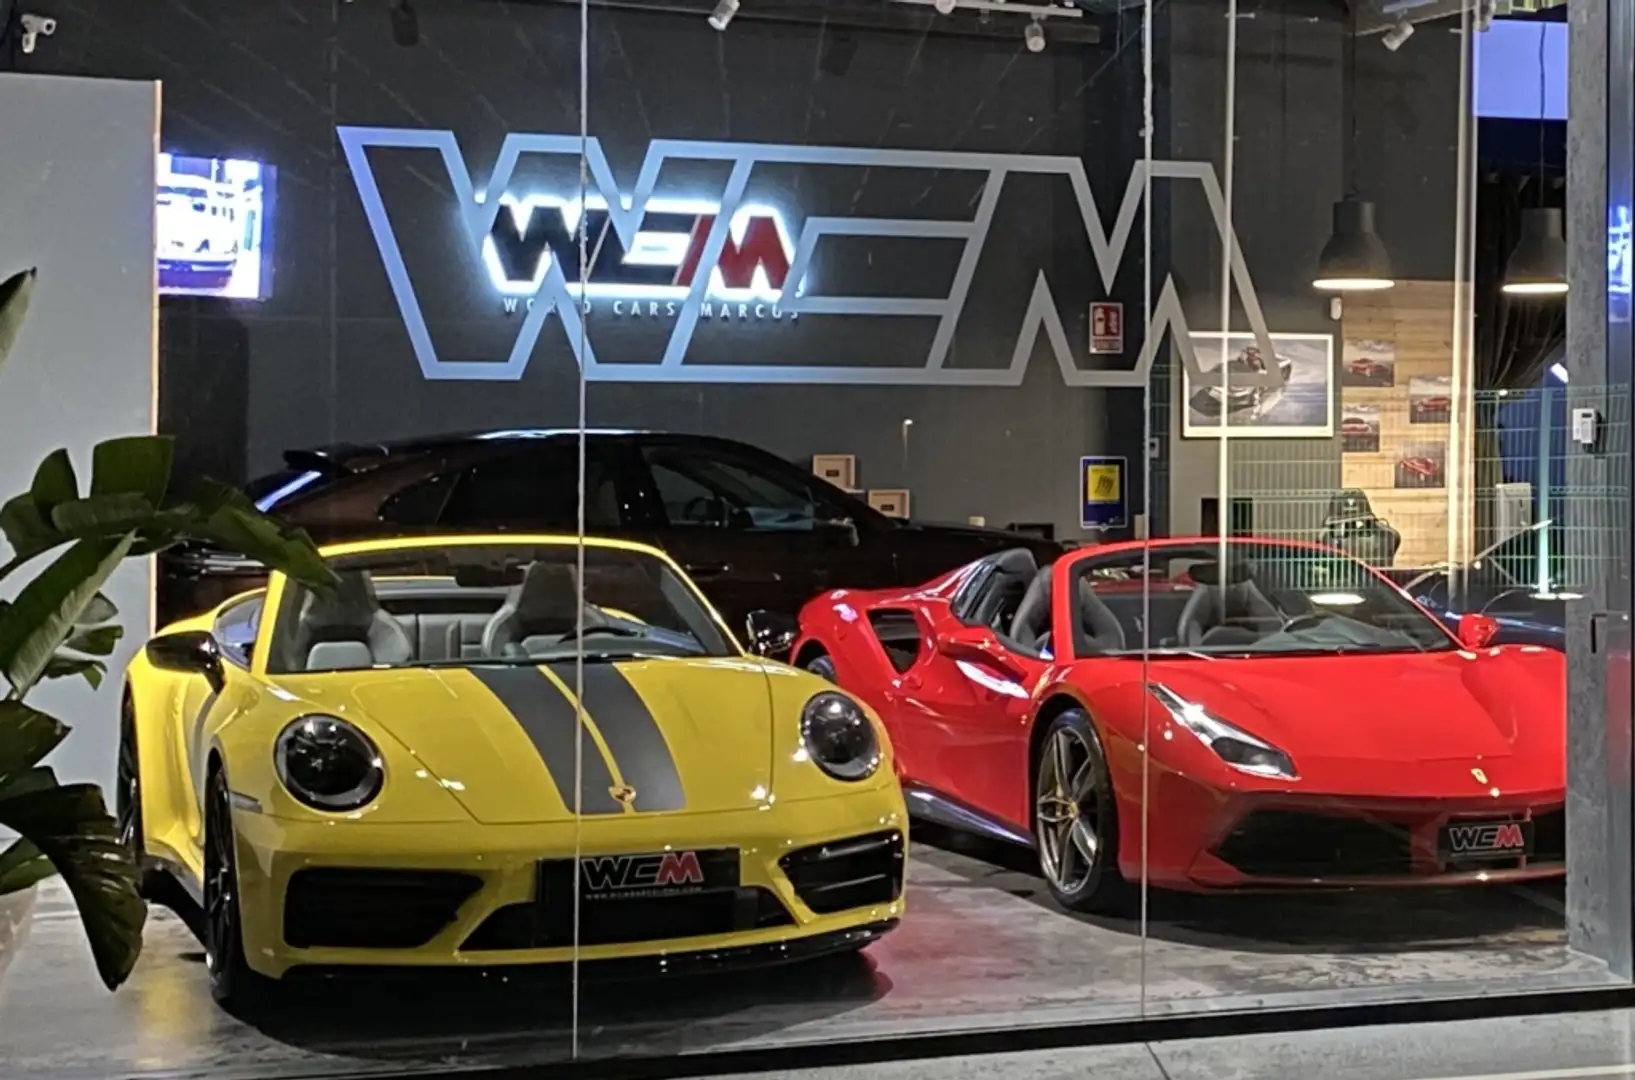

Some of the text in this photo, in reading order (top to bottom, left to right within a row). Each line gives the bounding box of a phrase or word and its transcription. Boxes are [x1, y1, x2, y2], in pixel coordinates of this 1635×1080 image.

[337, 126, 1282, 387] WCM
[487, 203, 796, 291] WCM
[503, 297, 592, 314] WOD
[612, 299, 677, 317] CARS
[1448, 824, 1524, 851] WCM
[581, 851, 704, 890] WCM
